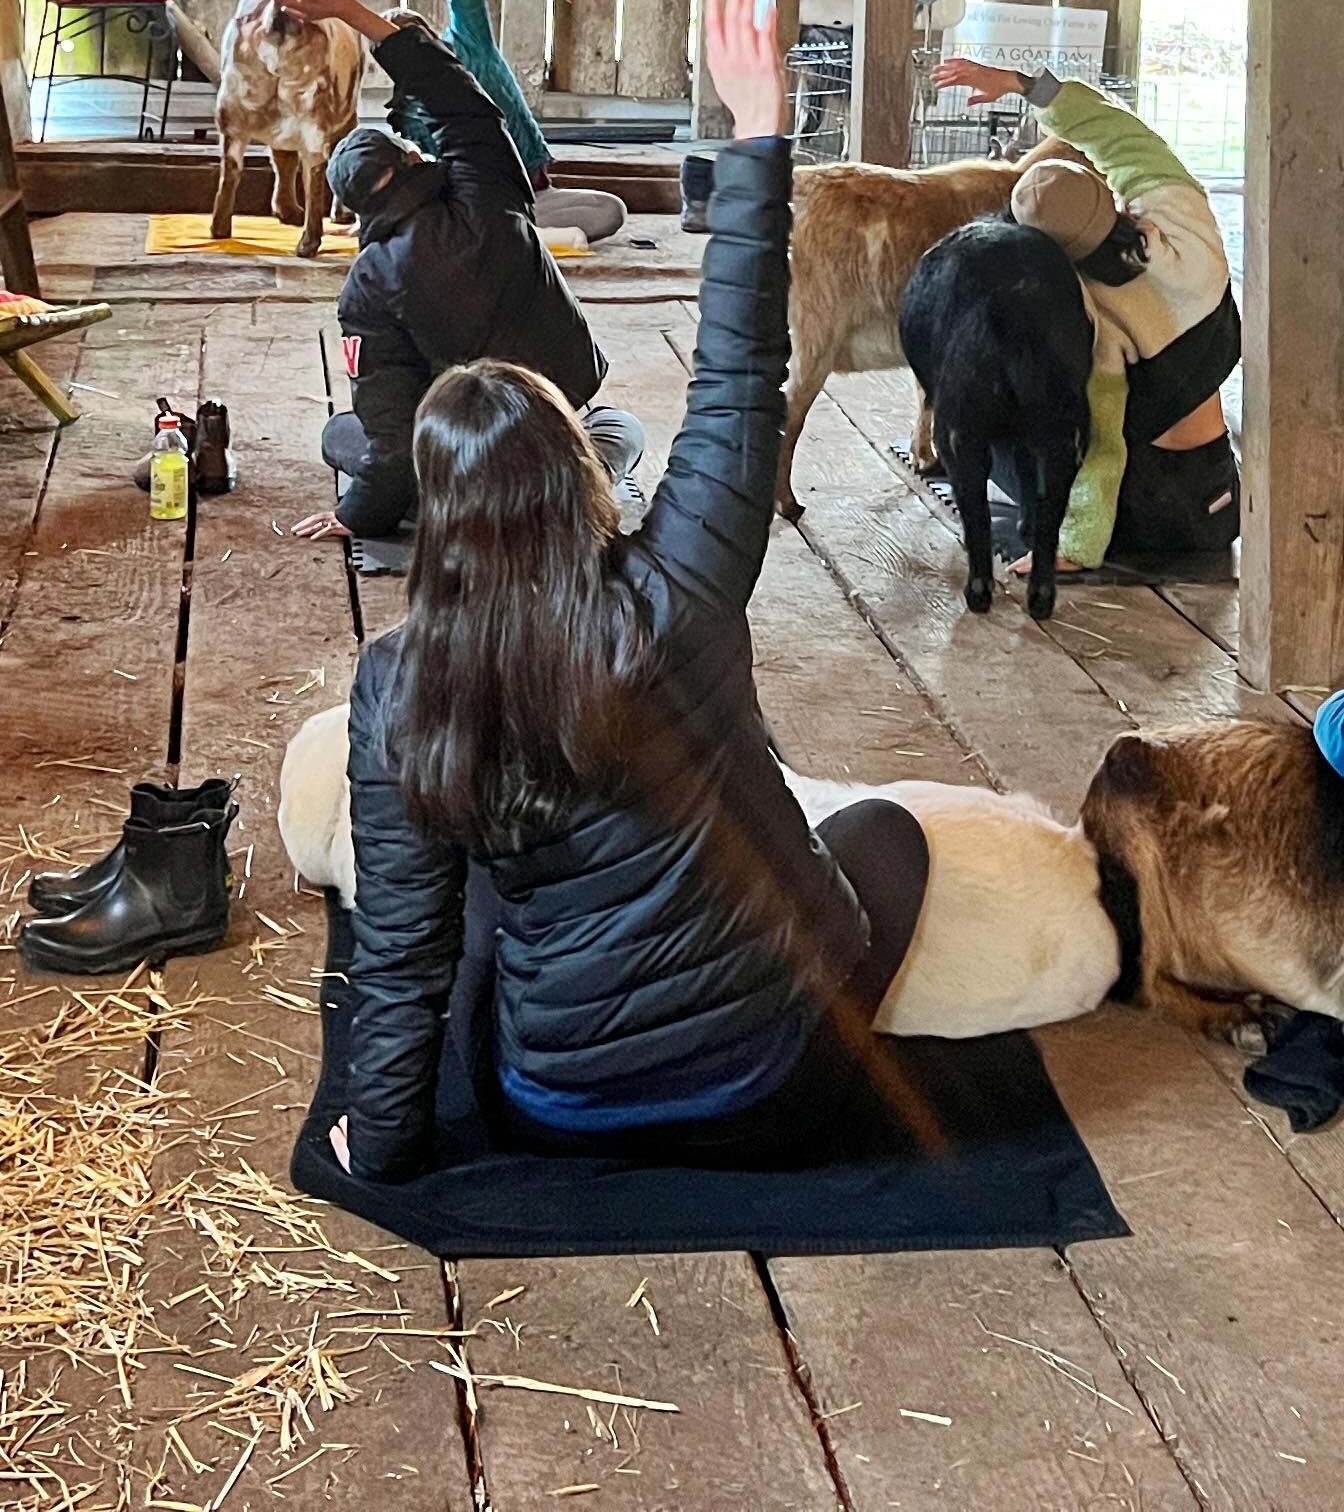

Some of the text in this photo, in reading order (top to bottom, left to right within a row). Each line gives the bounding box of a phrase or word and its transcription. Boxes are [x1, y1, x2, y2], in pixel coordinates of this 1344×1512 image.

[951, 44, 993, 60] HAVE
[995, 47, 1006, 61] A
[1009, 48, 1052, 65] GOAT
